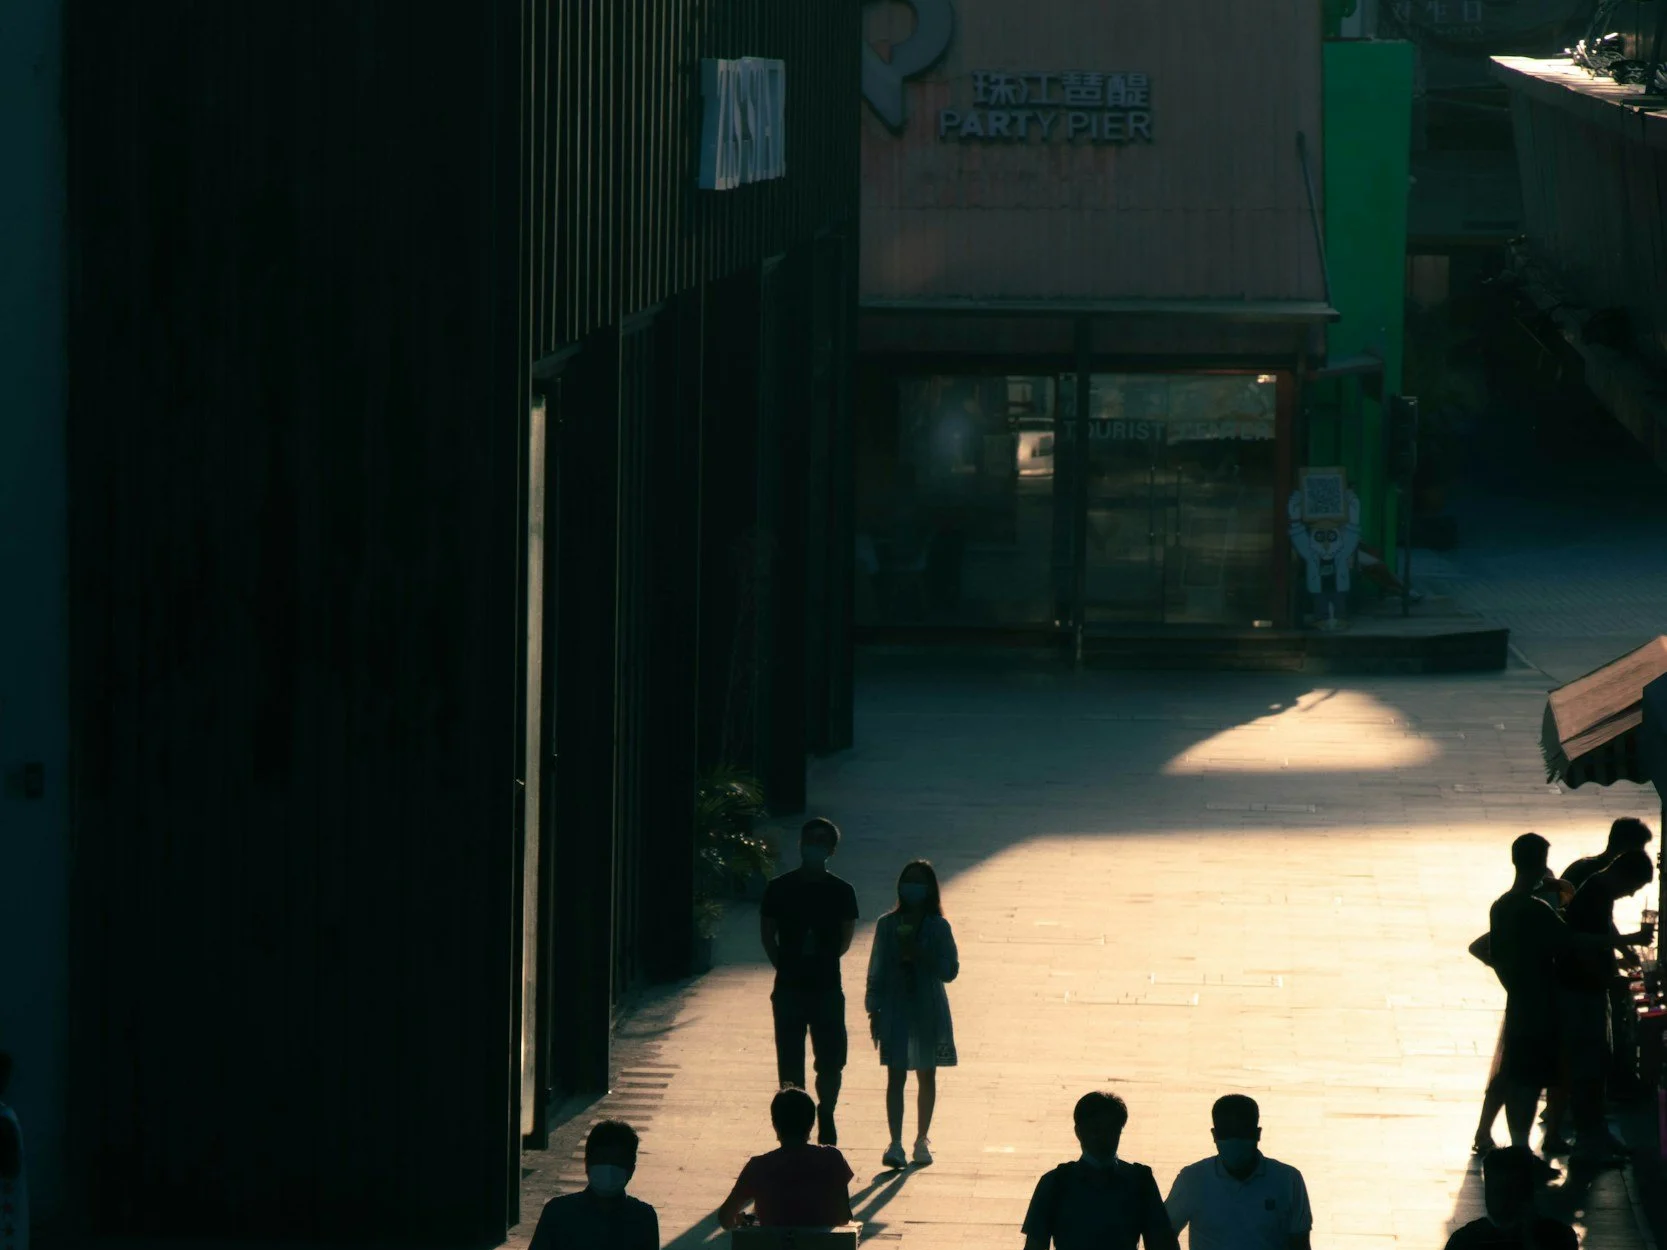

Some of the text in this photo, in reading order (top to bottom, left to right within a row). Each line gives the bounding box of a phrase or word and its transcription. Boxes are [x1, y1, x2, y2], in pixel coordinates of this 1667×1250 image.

[971, 69, 1149, 107] 珠江琶醍
[939, 110, 1152, 140] PARTY PIER
[1063, 420, 1166, 441] TURIST
